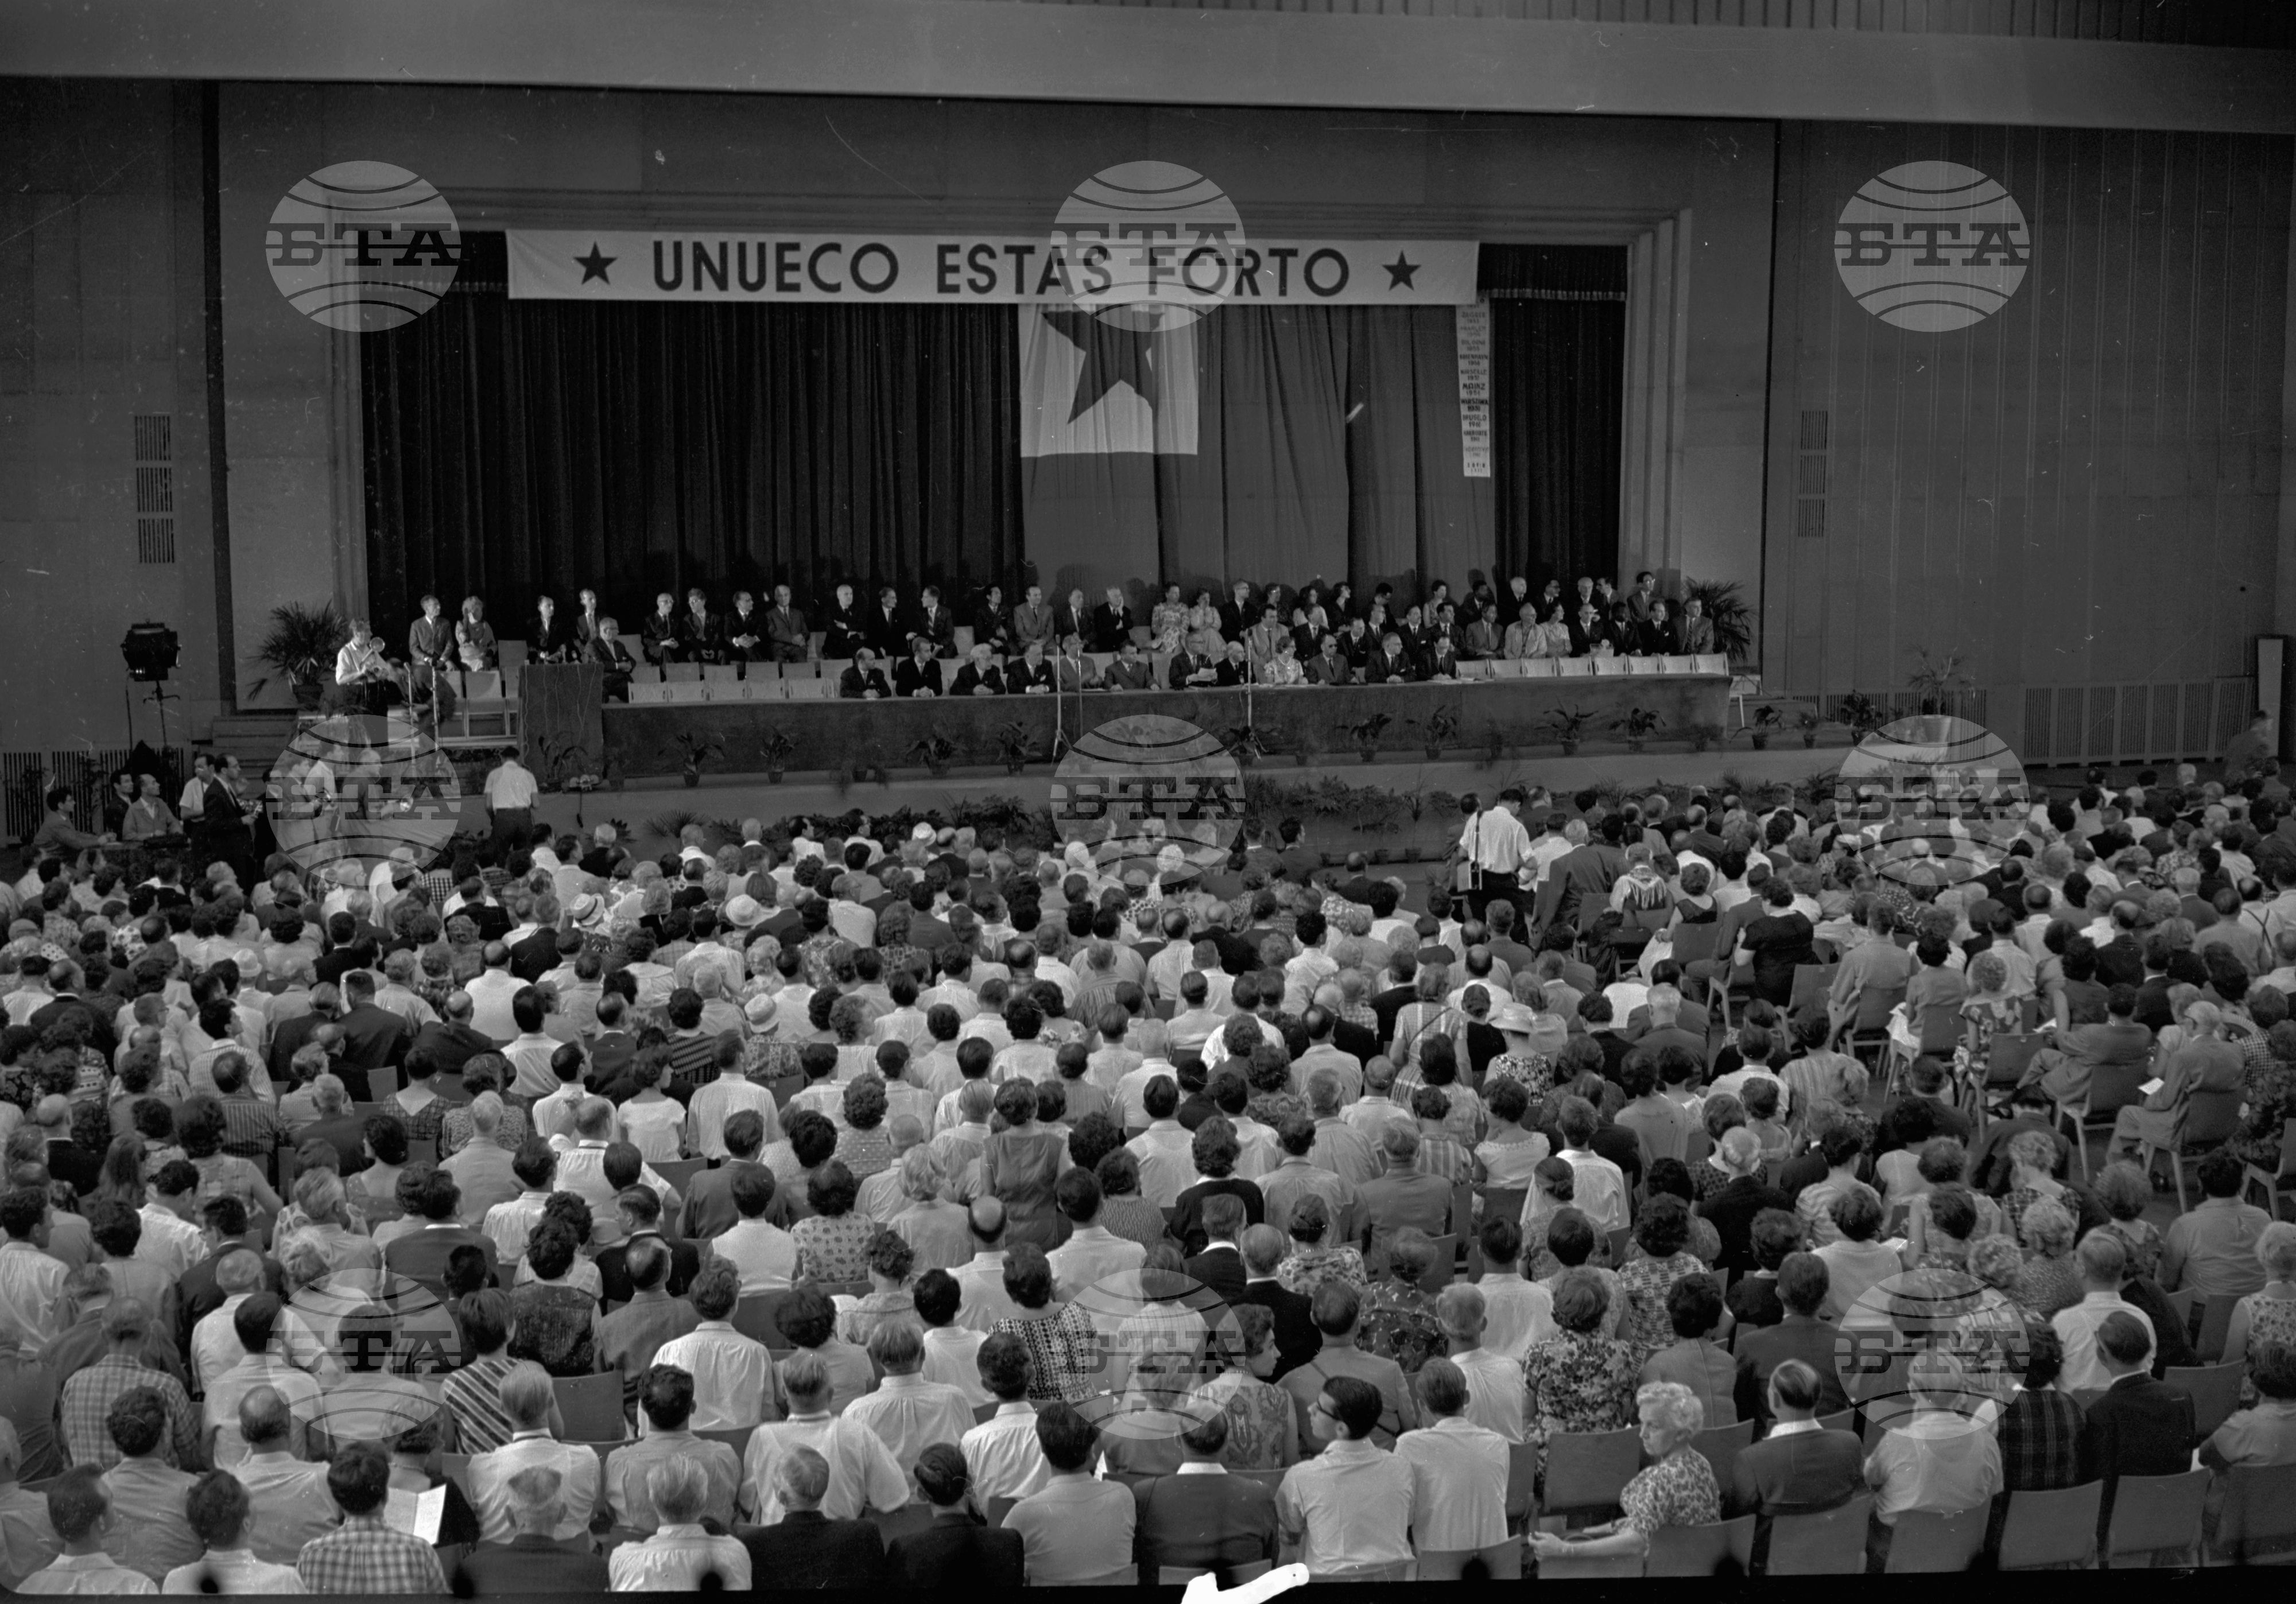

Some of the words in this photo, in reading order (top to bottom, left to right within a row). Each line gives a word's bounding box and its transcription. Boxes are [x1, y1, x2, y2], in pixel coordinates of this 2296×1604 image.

[653, 240, 899, 294] UNUECO
[937, 243, 1112, 296] ESTAS
[1149, 246, 1349, 297] FORTO
[1462, 382, 1486, 390] MAINZ
